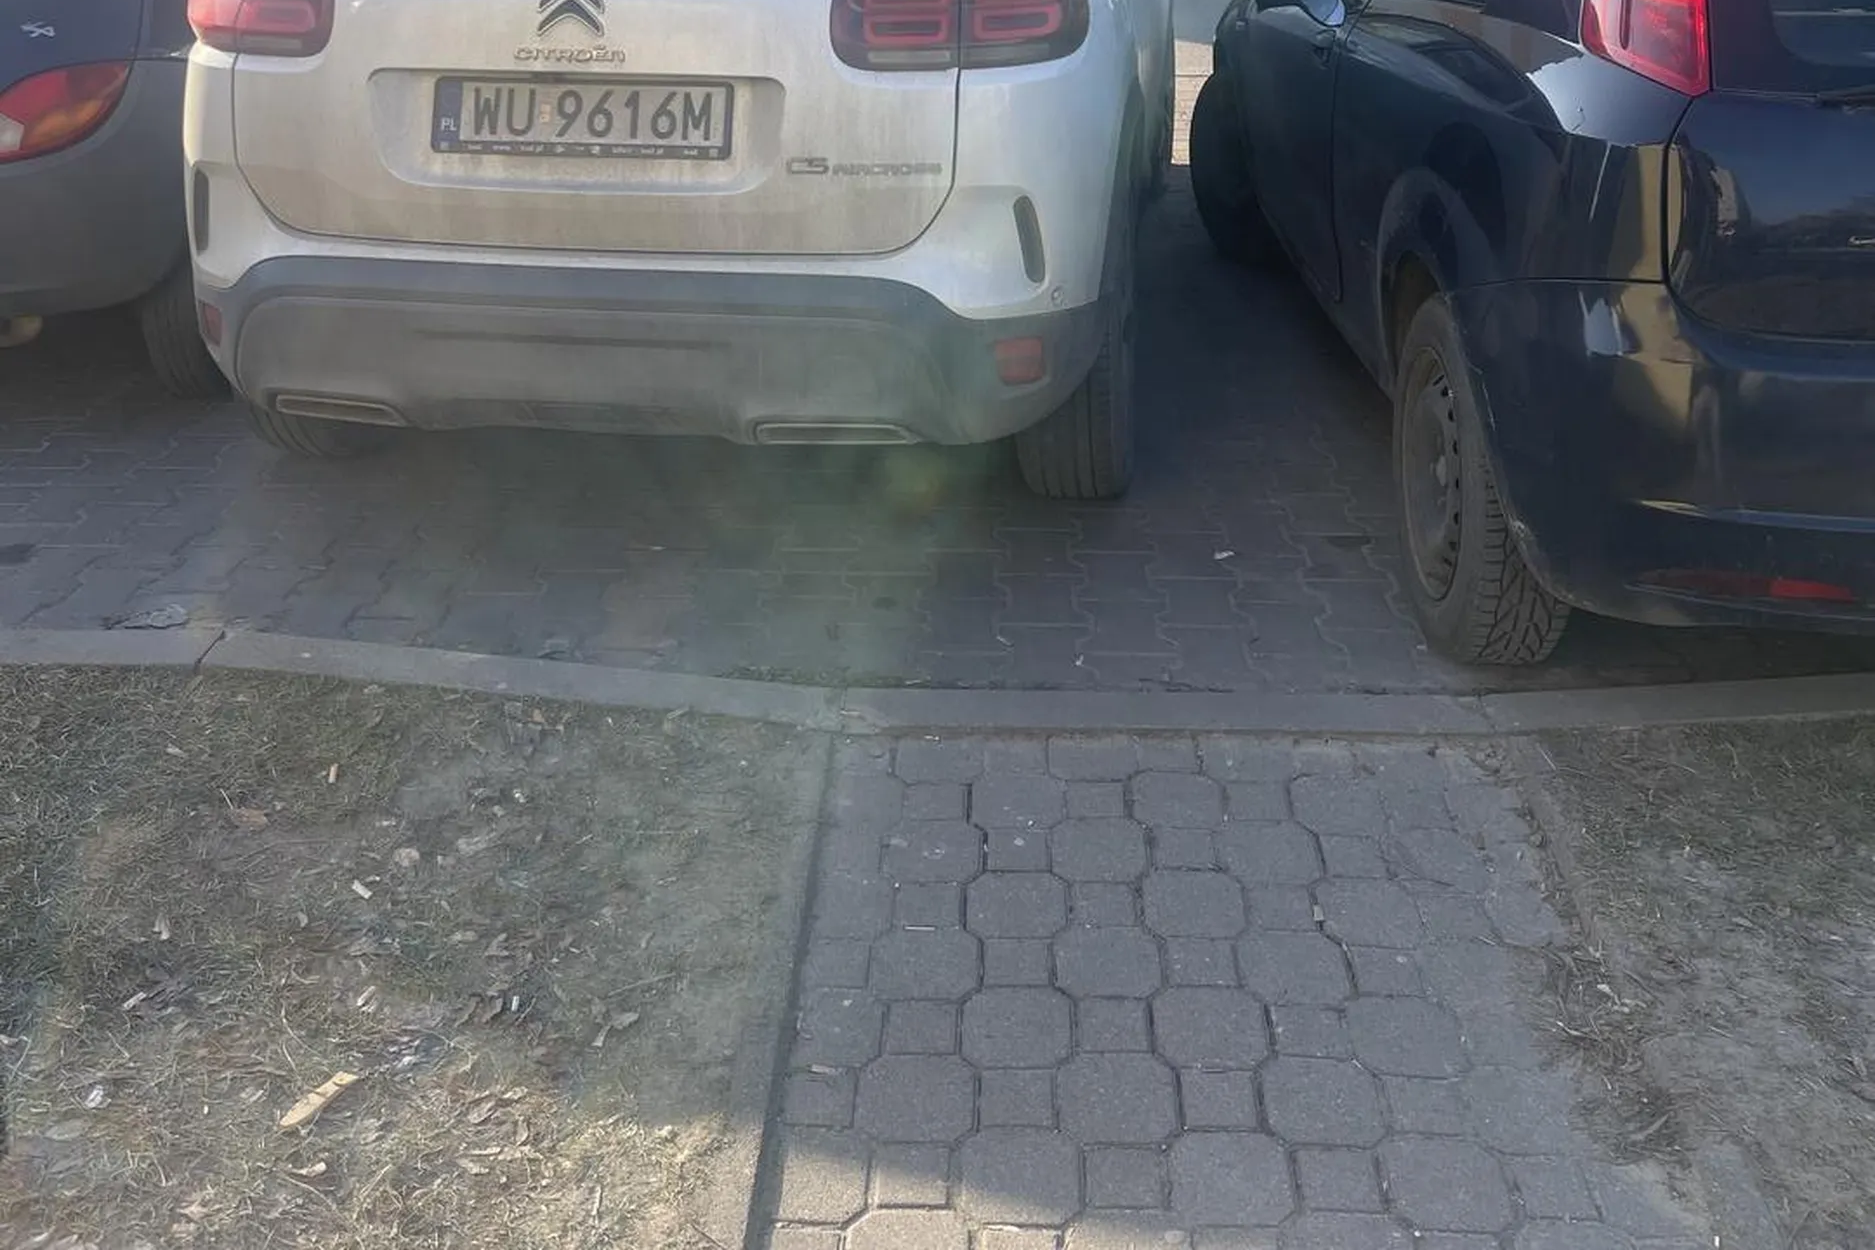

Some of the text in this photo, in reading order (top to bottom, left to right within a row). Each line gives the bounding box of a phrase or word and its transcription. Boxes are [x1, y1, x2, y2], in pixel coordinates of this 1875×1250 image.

[441, 118, 457, 130] PL
[473, 86, 713, 141] WU 9616M
